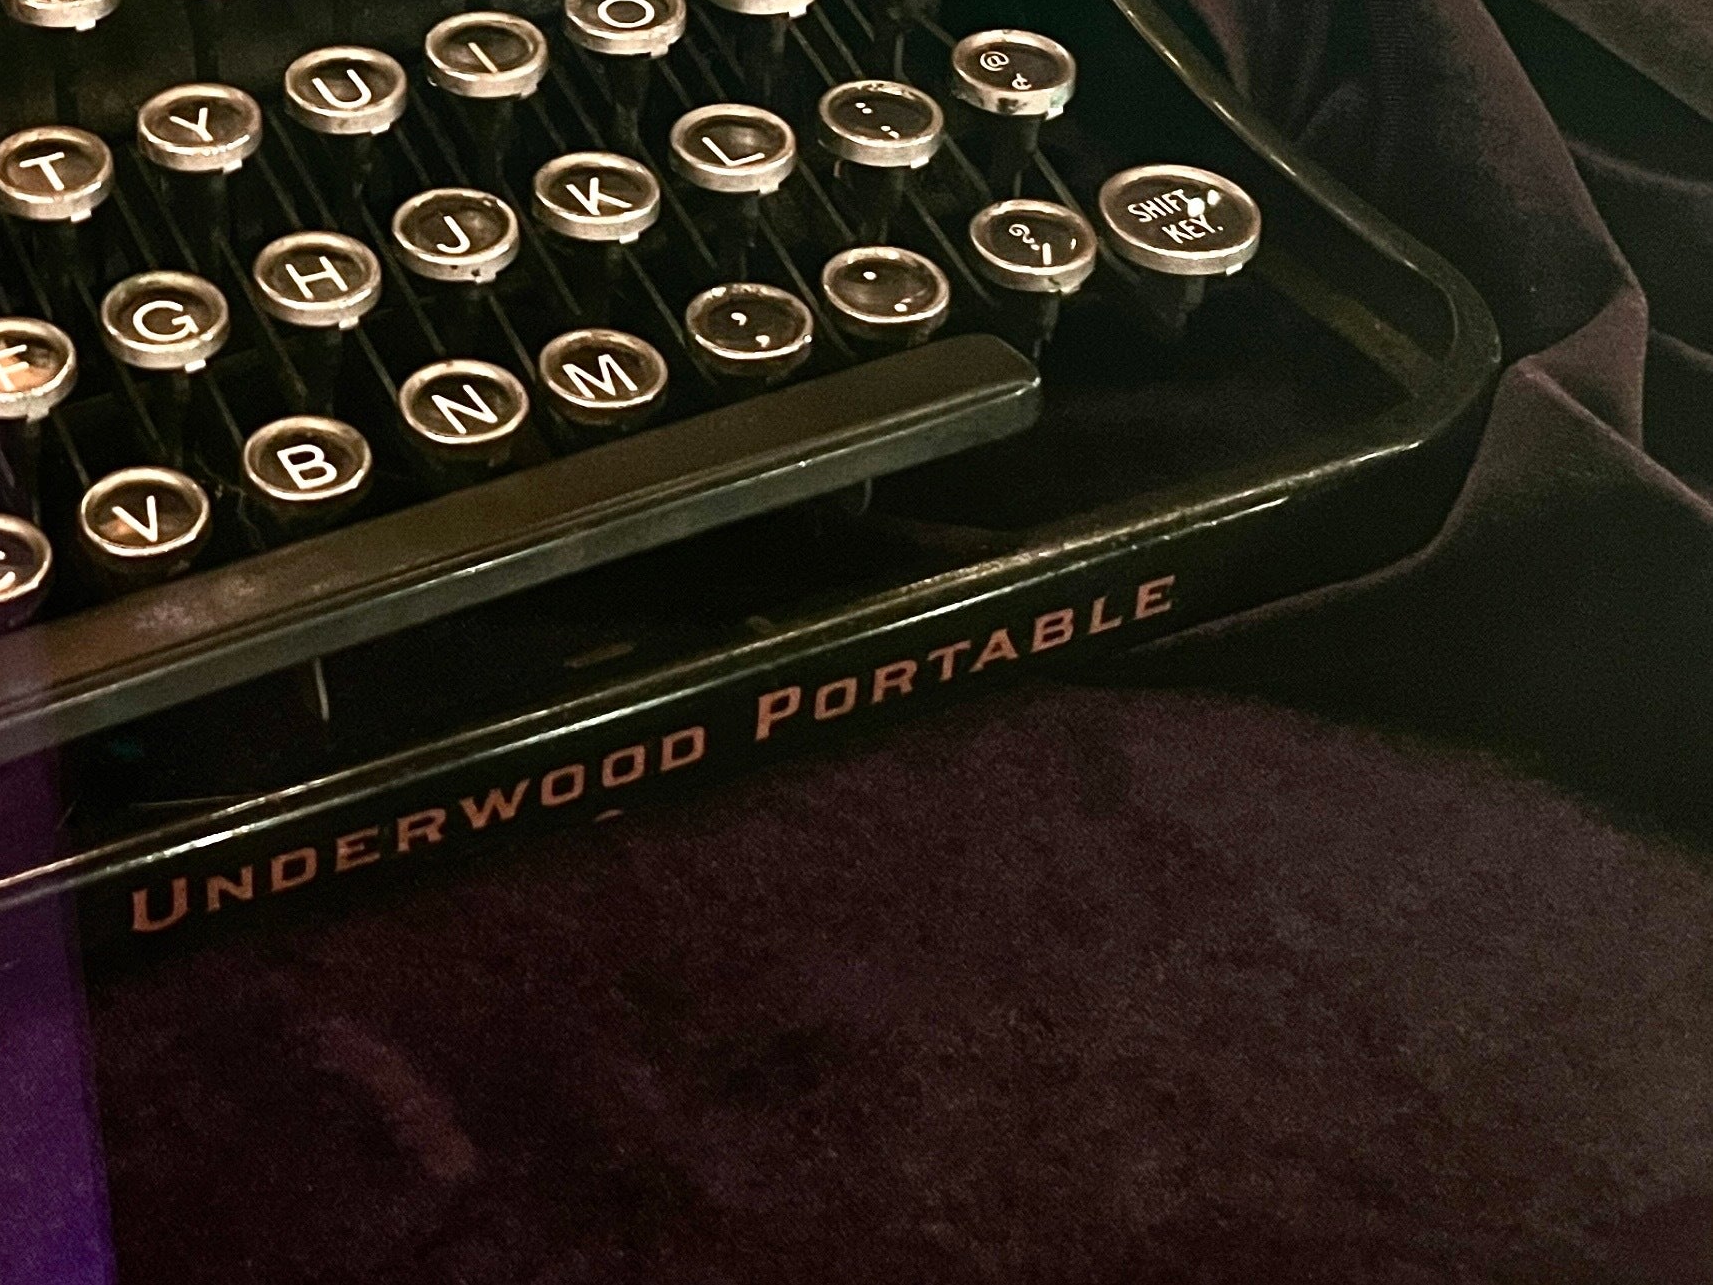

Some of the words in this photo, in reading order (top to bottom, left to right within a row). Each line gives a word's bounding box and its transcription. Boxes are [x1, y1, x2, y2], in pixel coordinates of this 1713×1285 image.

[979, 51, 1010, 72] @
[311, 68, 372, 109] U
[169, 107, 214, 143] Y
[19, 152, 65, 191] T
[701, 136, 765, 167] L
[565, 176, 633, 217] K
[1127, 188, 1193, 223] SHIFT
[435, 214, 471, 254] J
[1008, 223, 1040, 251] ?
[1161, 214, 1224, 244] KEY.
[284, 255, 348, 300] H
[132, 300, 199, 342] G
[562, 352, 639, 400] M
[431, 383, 500, 435] N
[276, 443, 338, 491] B
[111, 494, 158, 543] V
[131, 724, 708, 934] UNDERWOOD
[755, 574, 1177, 741] PORTABLE
